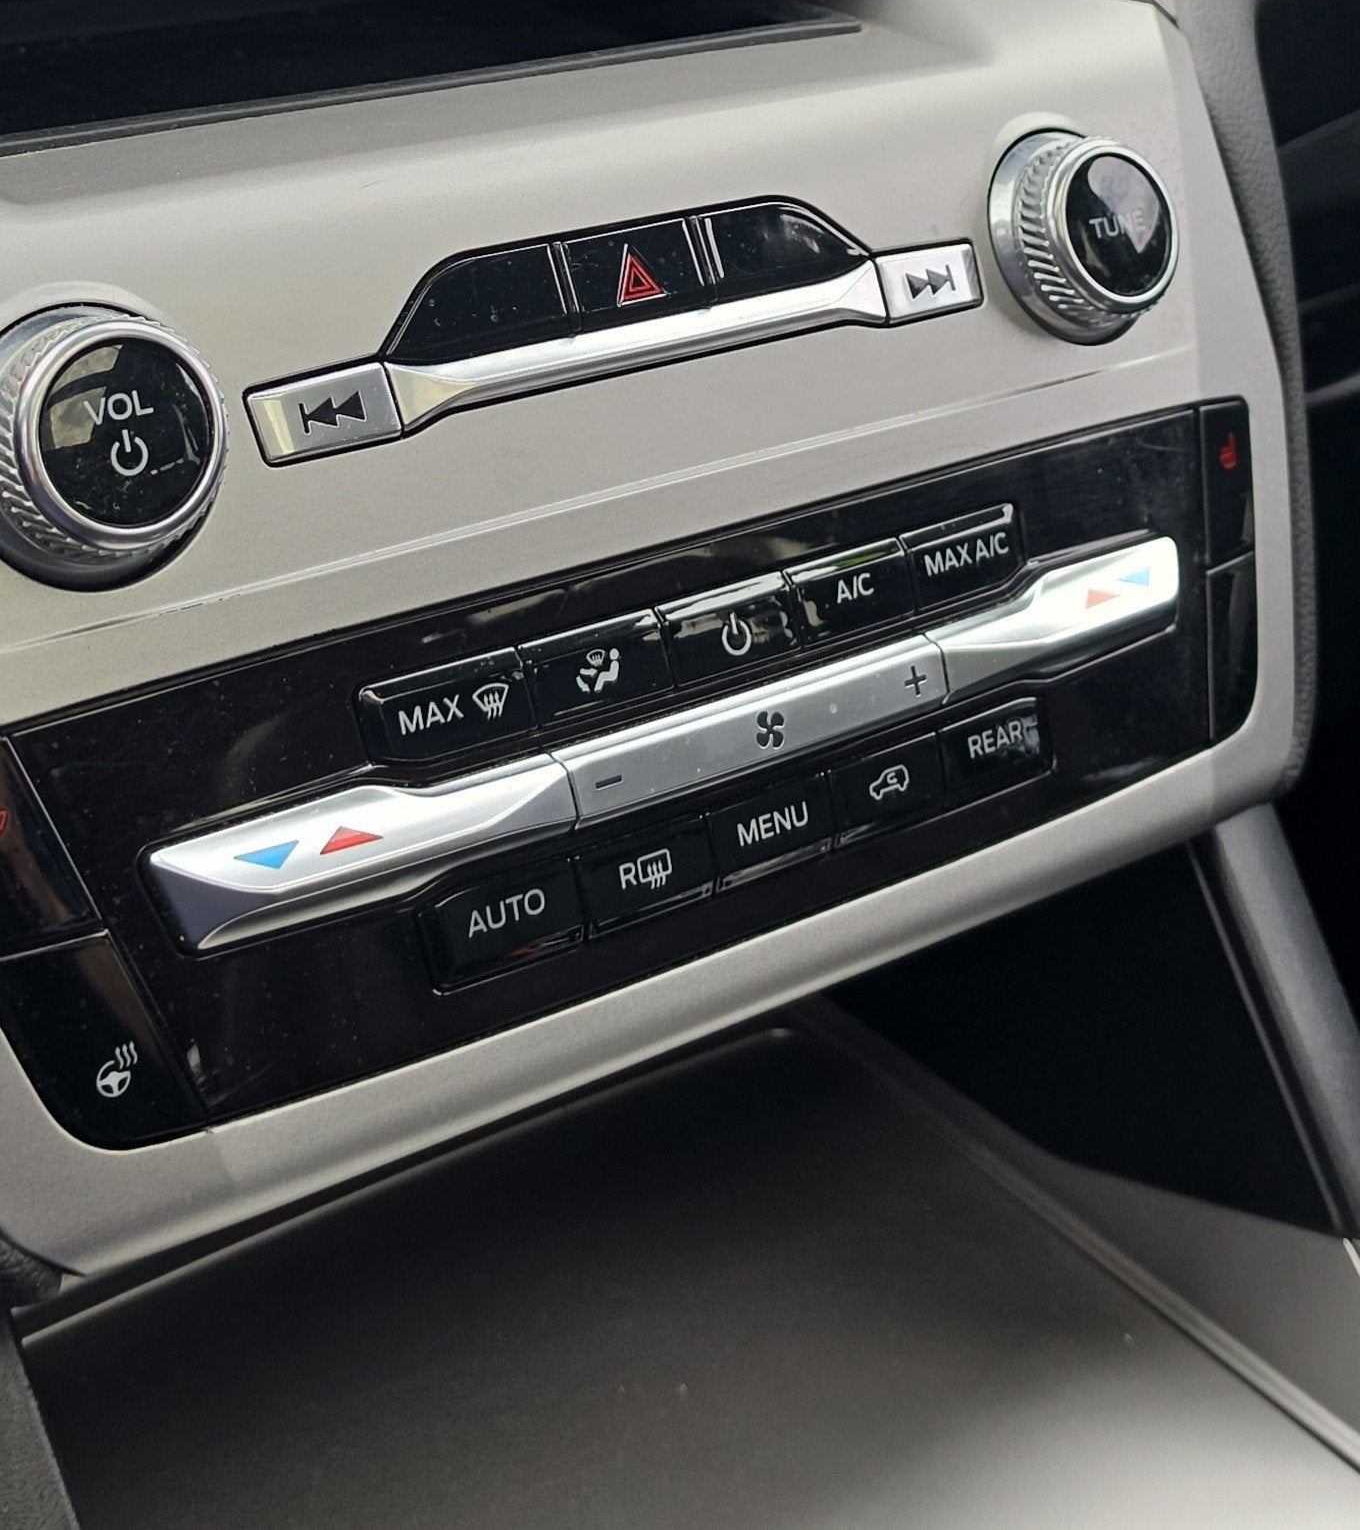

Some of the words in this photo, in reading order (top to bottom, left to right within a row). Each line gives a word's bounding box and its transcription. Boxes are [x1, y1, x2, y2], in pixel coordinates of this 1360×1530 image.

[1088, 209, 1145, 239] TUNE
[83, 389, 155, 426] VOL
[924, 541, 974, 577] MAX
[975, 530, 1011, 560] A/C
[836, 572, 876, 604] A/C
[397, 694, 465, 737] MAX
[967, 719, 1024, 759] REAR
[736, 802, 810, 848] MENU
[619, 862, 636, 890] R
[467, 888, 546, 938] AUTO
